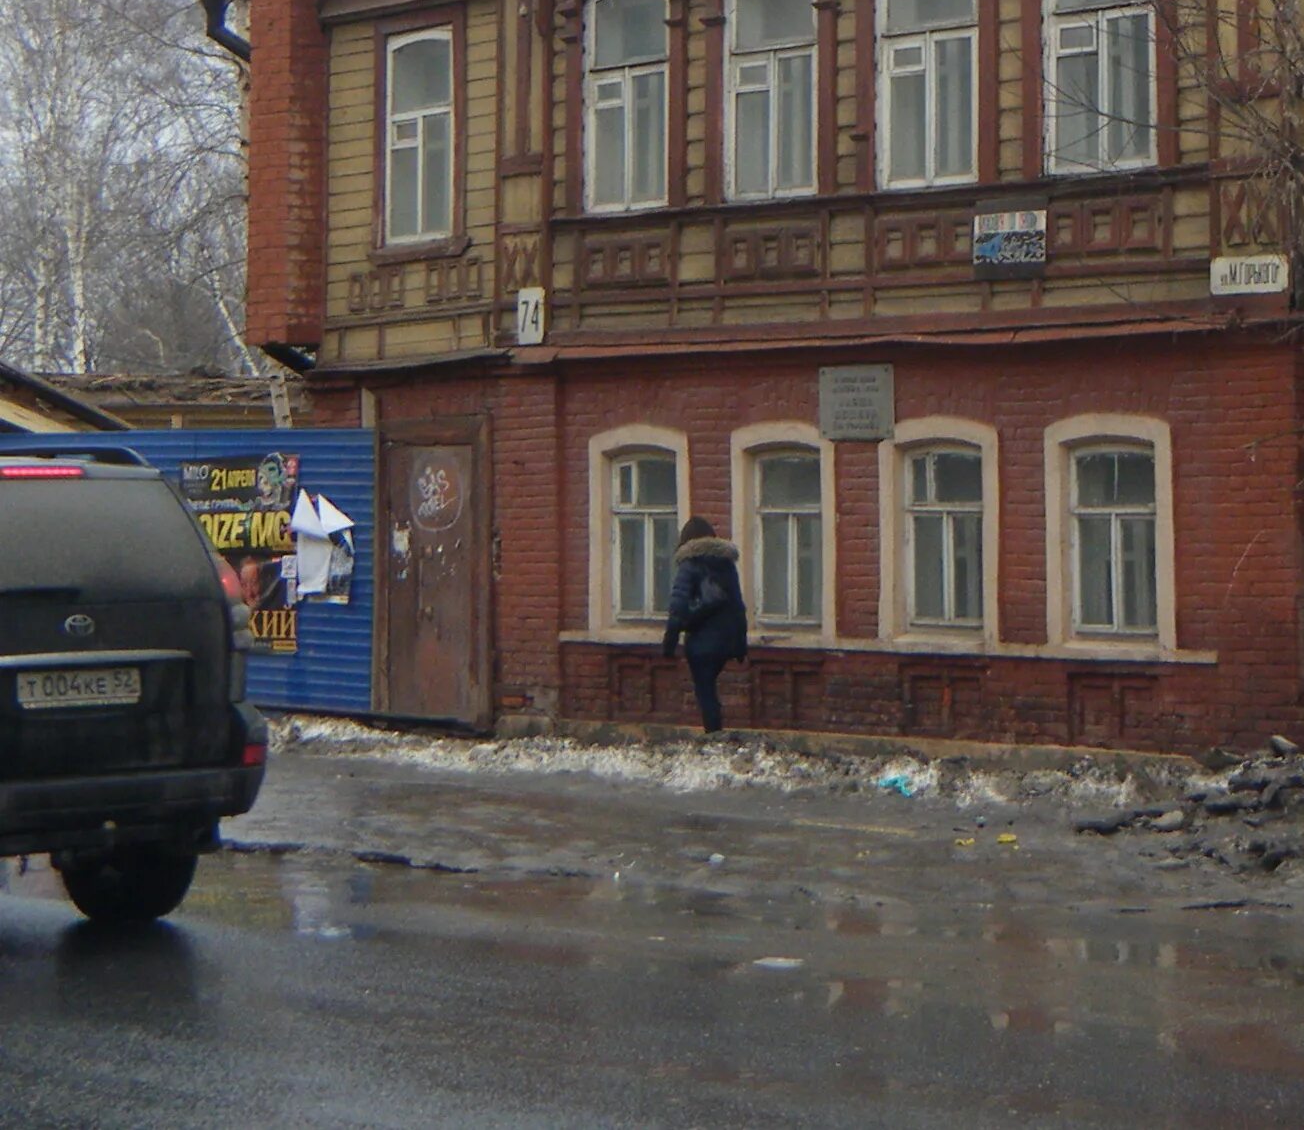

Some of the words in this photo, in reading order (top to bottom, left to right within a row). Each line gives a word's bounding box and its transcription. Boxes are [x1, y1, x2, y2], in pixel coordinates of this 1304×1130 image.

[521, 300, 539, 333] 74
[211, 468, 227, 491] 21
[113, 670, 132, 687] 52
